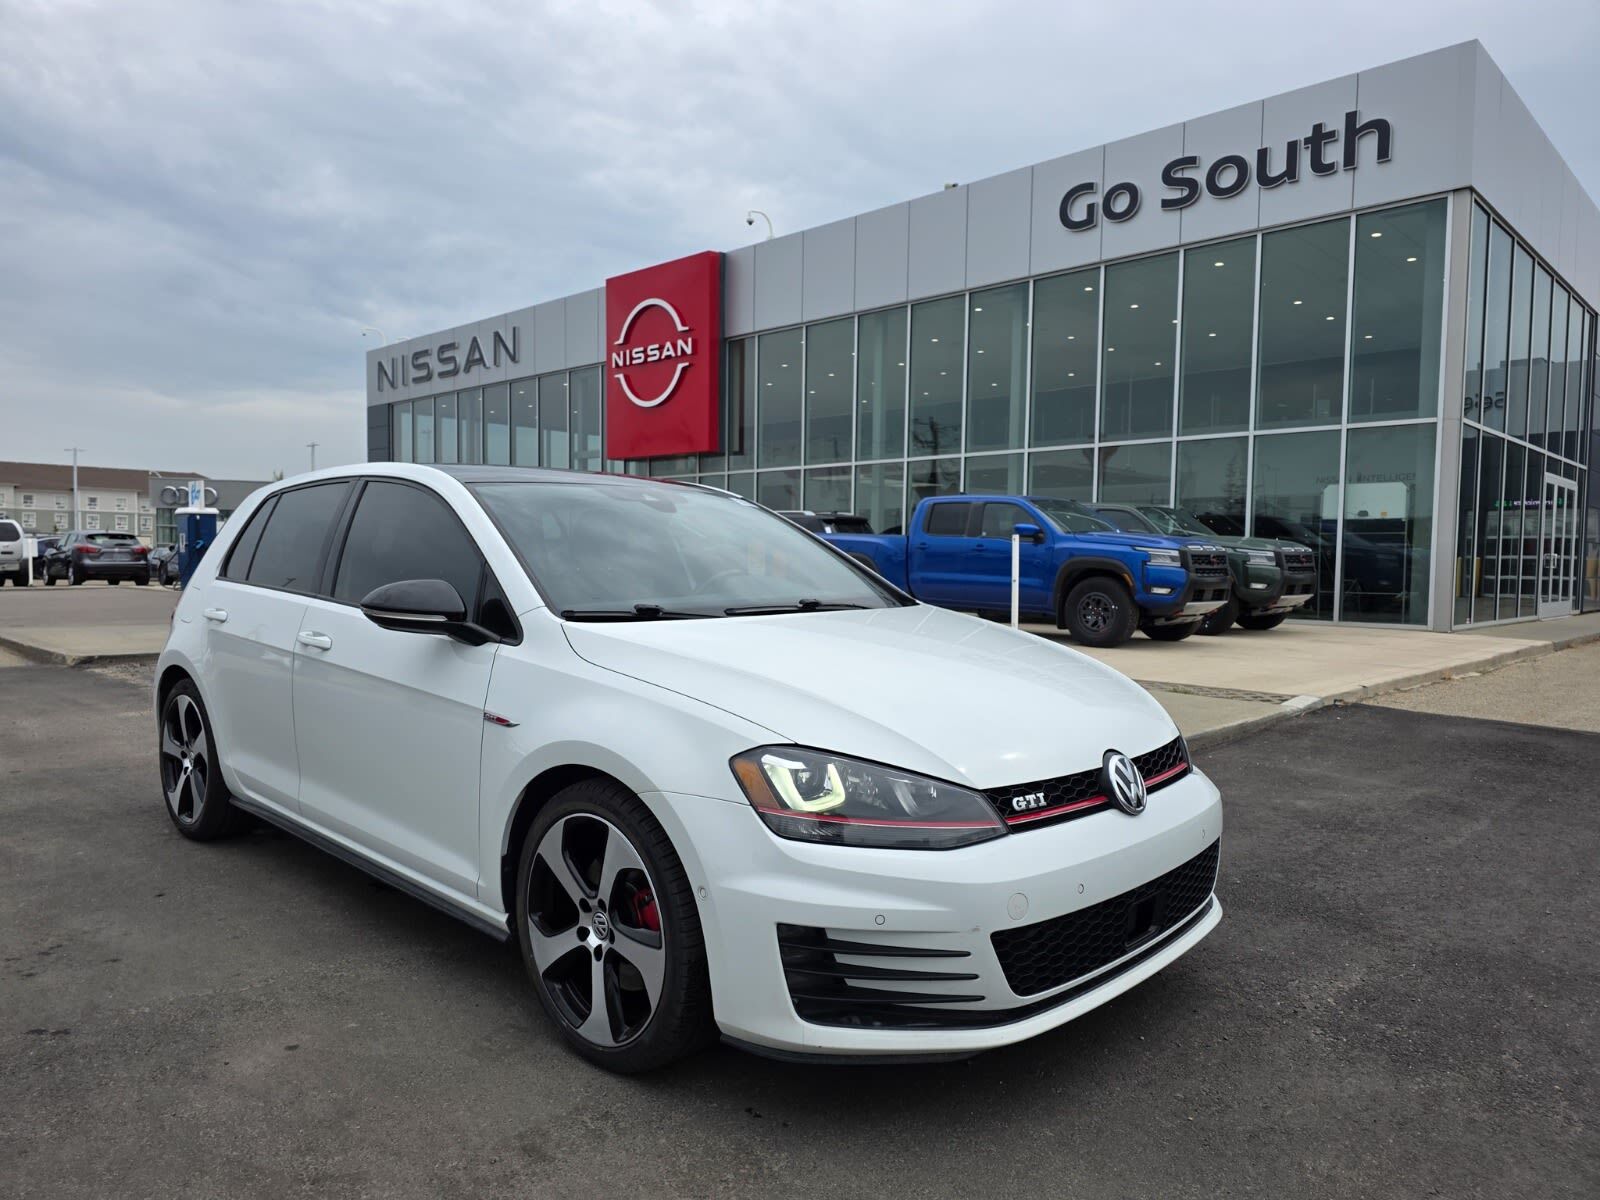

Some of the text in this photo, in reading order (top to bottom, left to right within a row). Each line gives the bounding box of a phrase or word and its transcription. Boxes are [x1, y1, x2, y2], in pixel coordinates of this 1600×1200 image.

[1059, 110, 1393, 232] Go South
[377, 326, 520, 392] NISSAN
[612, 337, 693, 368] NISSAN
[1012, 792, 1047, 812] GTI
